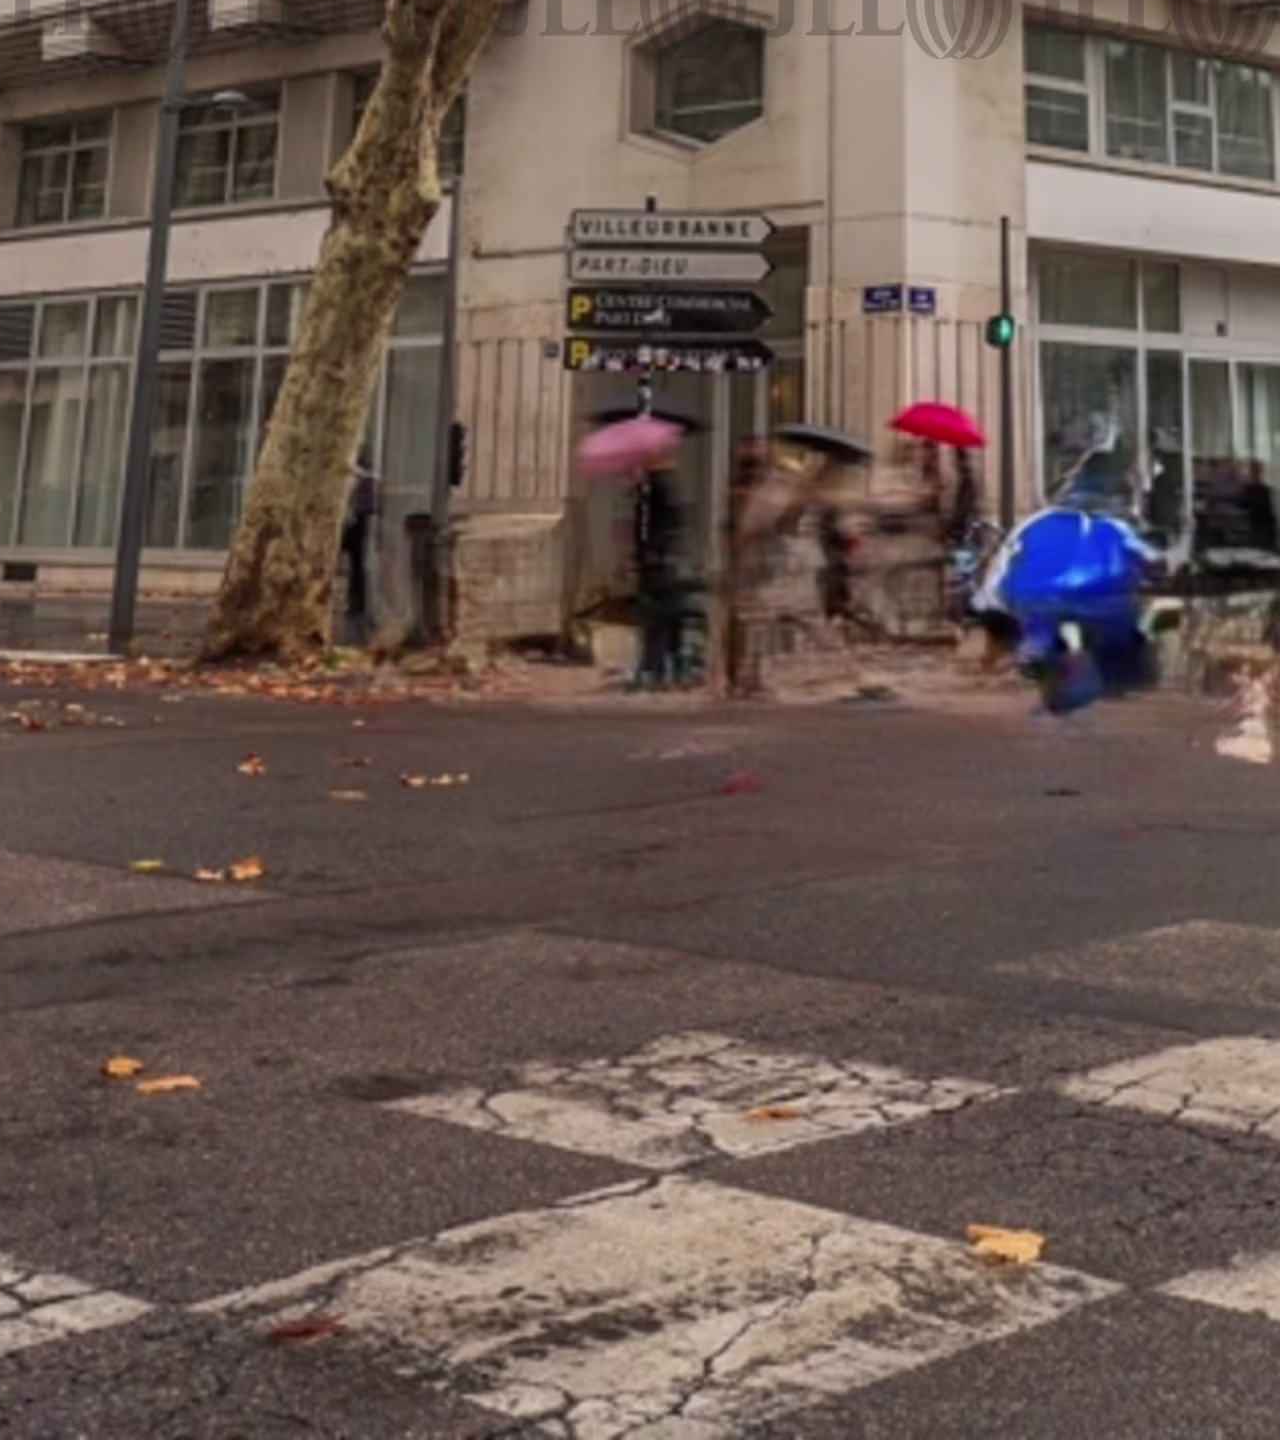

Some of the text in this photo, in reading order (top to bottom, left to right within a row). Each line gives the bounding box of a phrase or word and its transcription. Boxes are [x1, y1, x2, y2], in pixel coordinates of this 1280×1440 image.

[580, 219, 752, 239] VILLEURBANNE
[577, 256, 690, 277] PART-DIEU
[571, 295, 593, 322] P
